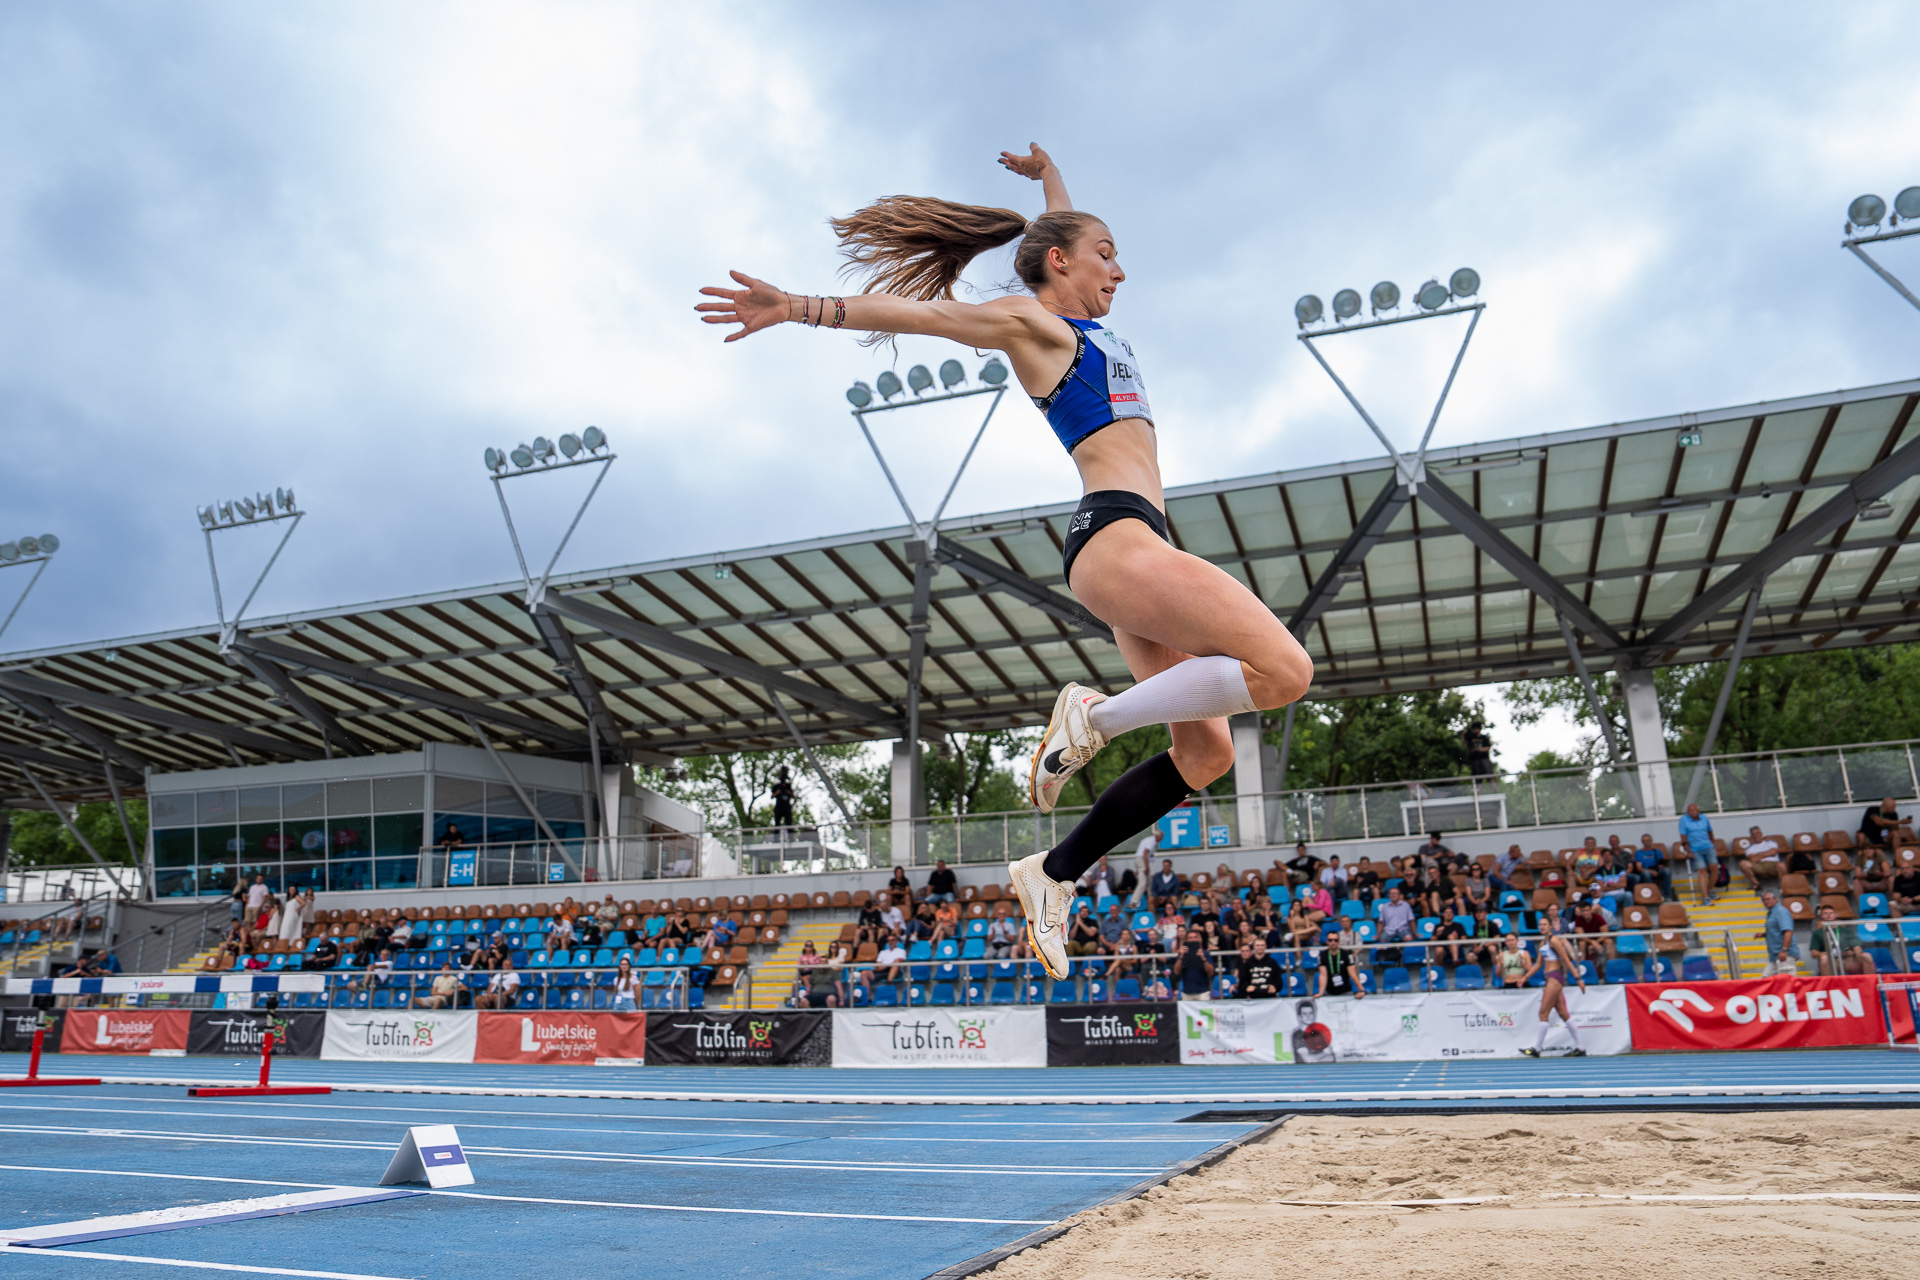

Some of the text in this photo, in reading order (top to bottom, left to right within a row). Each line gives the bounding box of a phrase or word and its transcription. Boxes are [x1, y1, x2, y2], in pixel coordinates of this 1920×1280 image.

[1063, 366, 1077, 383] NIKE
[1047, 387, 1061, 403] NIKE
[1170, 818, 1189, 846] F
[1210, 829, 1228, 838] WC
[450, 863, 474, 877] E-H
[1725, 988, 1865, 1025] ORLEN
[728, 1050, 773, 1059] INSPIRACJI
